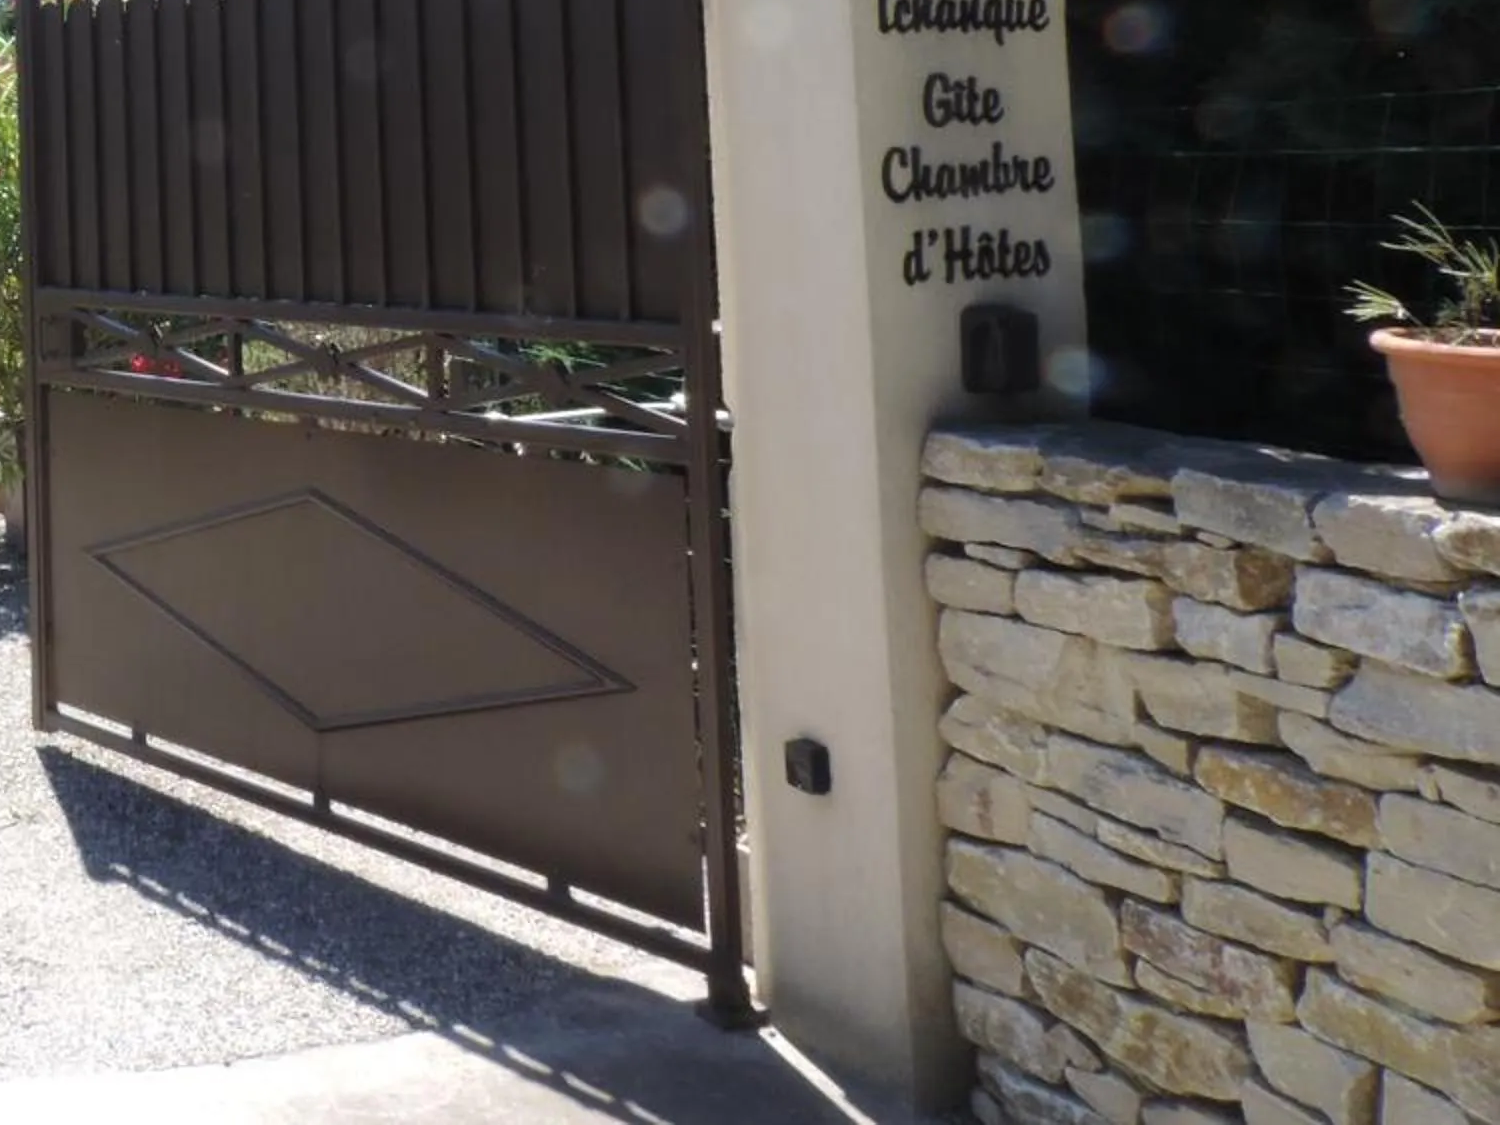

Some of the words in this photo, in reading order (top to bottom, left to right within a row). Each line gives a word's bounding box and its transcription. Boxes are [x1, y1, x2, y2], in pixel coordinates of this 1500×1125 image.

[922, 72, 1004, 128] Gîte
[880, 141, 1055, 203] Chambre
[903, 225, 1051, 285] d'Hôtes
